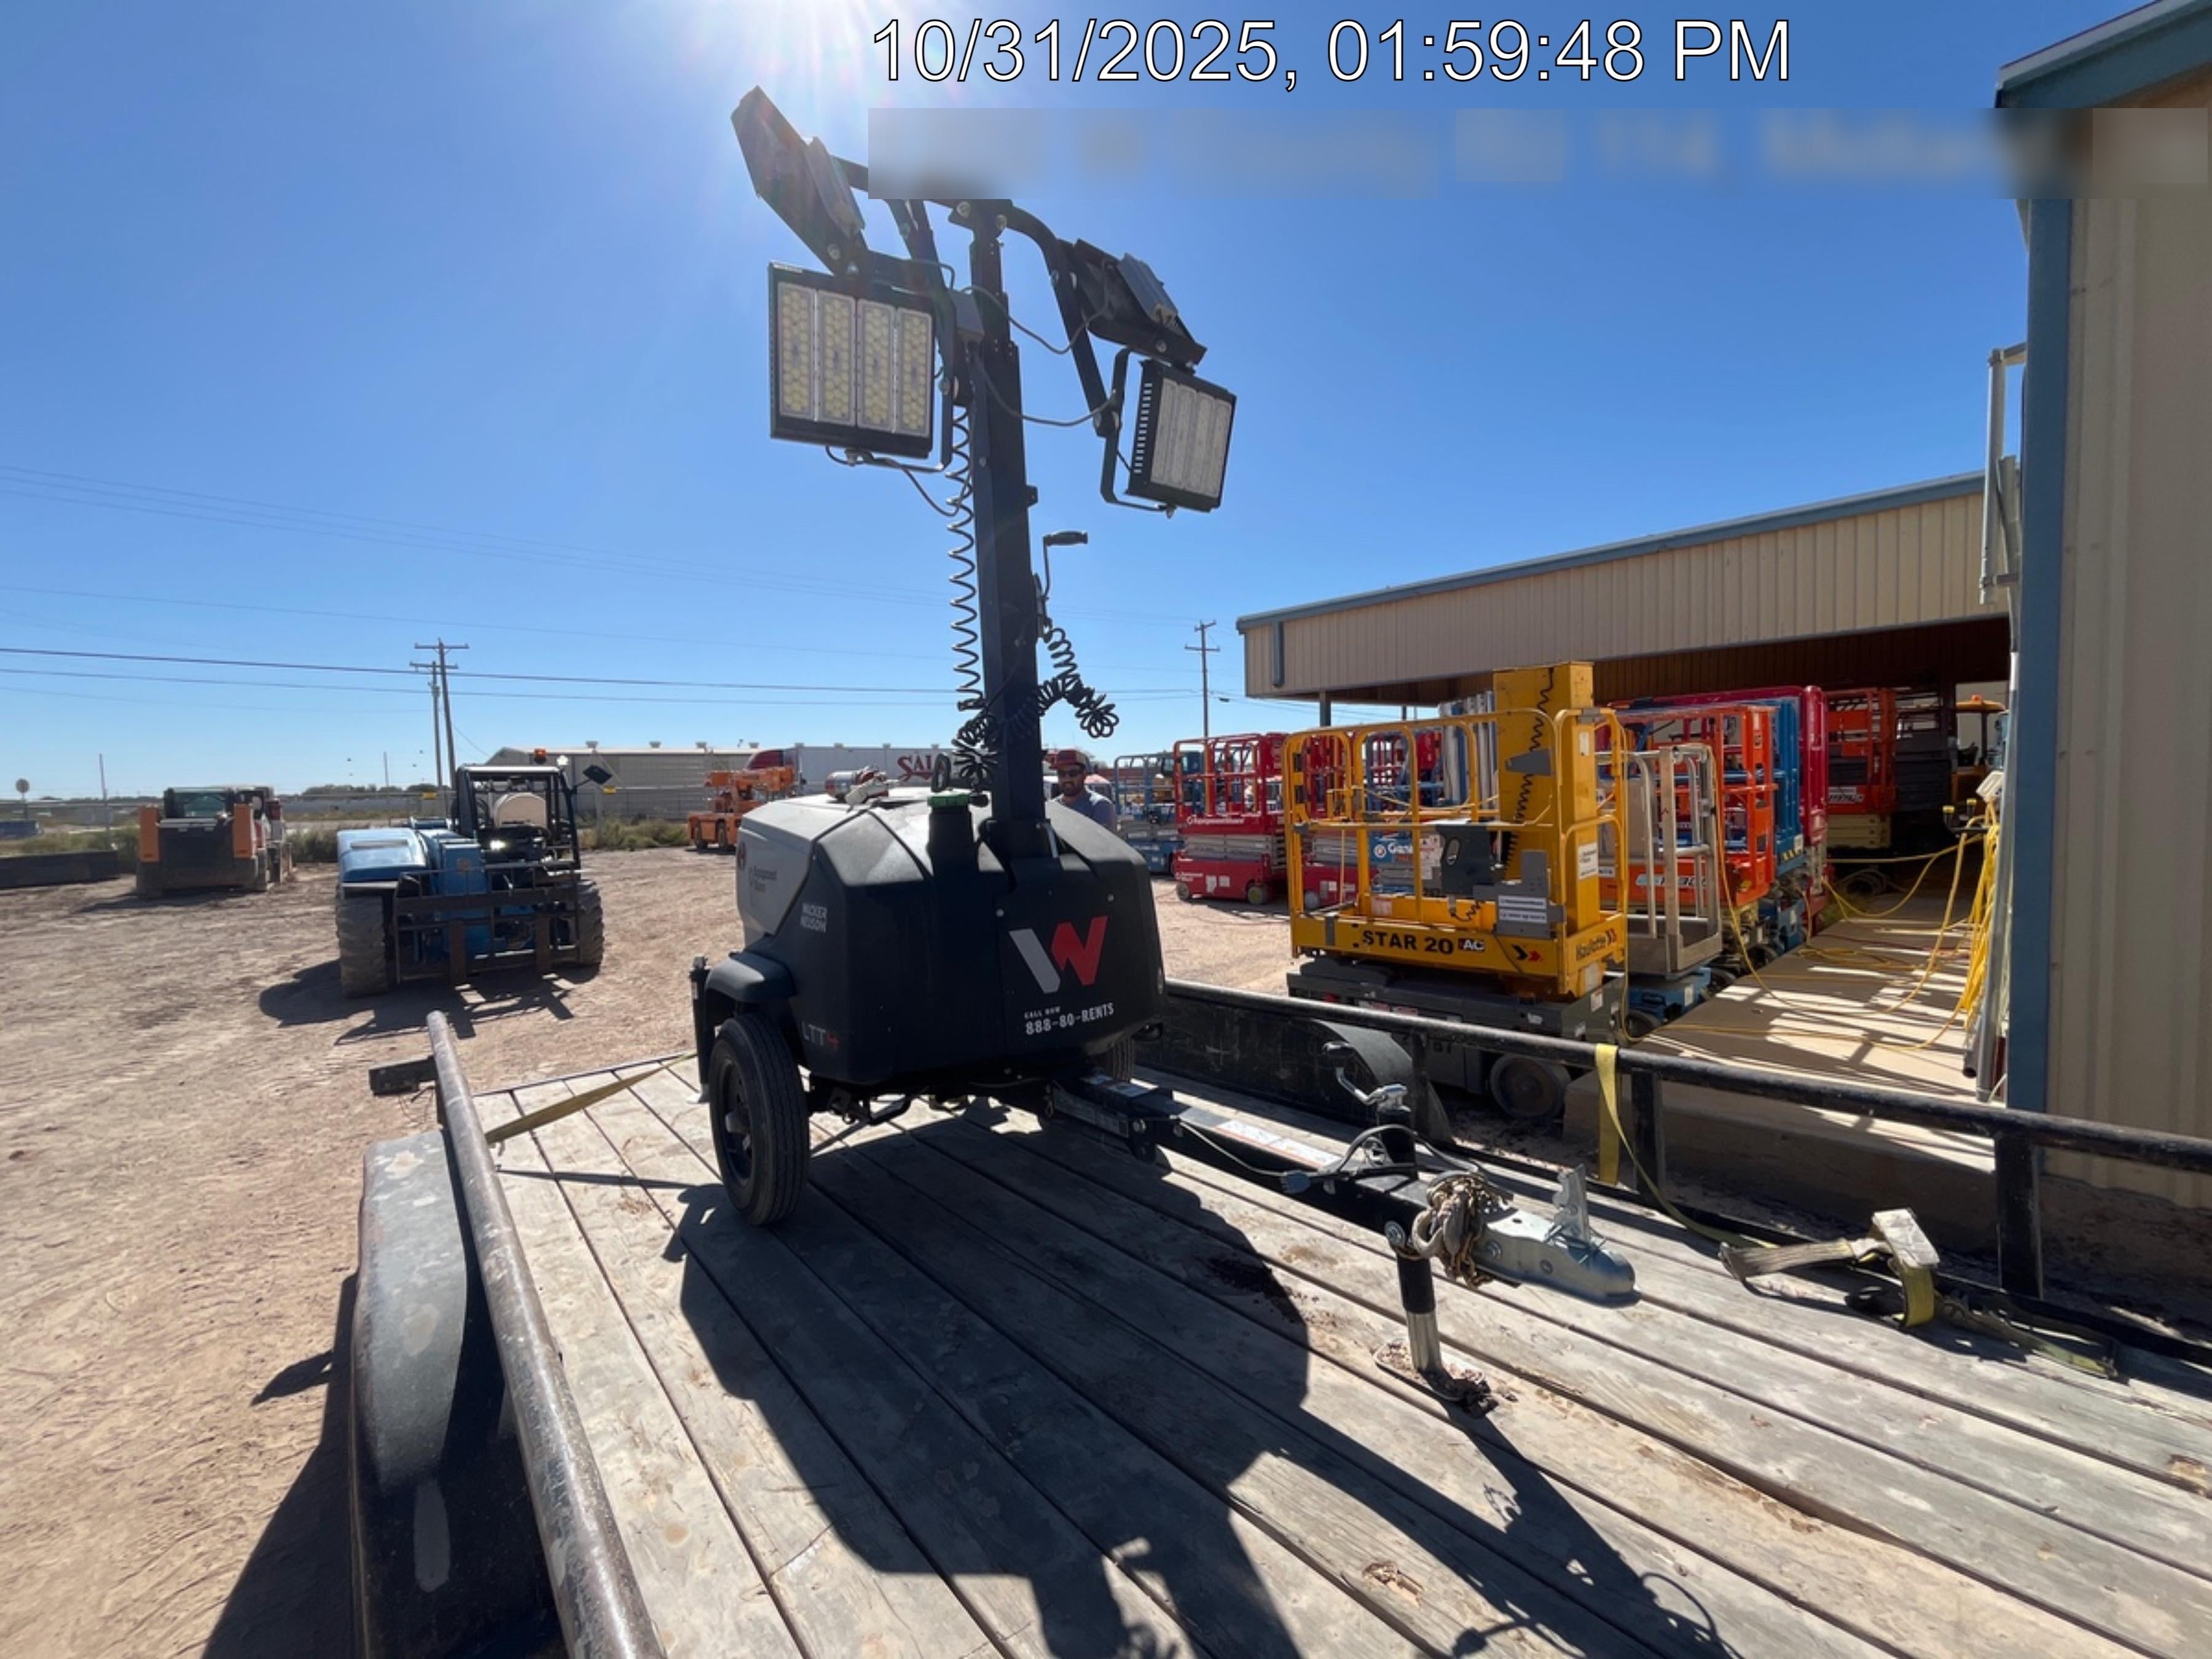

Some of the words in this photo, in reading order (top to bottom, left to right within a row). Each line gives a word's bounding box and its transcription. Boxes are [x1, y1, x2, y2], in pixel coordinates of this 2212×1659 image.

[1363, 930, 1417, 950] STAR
[1424, 936, 1454, 954] 20
[1026, 1002, 1114, 1035] 888-80-RENTS
